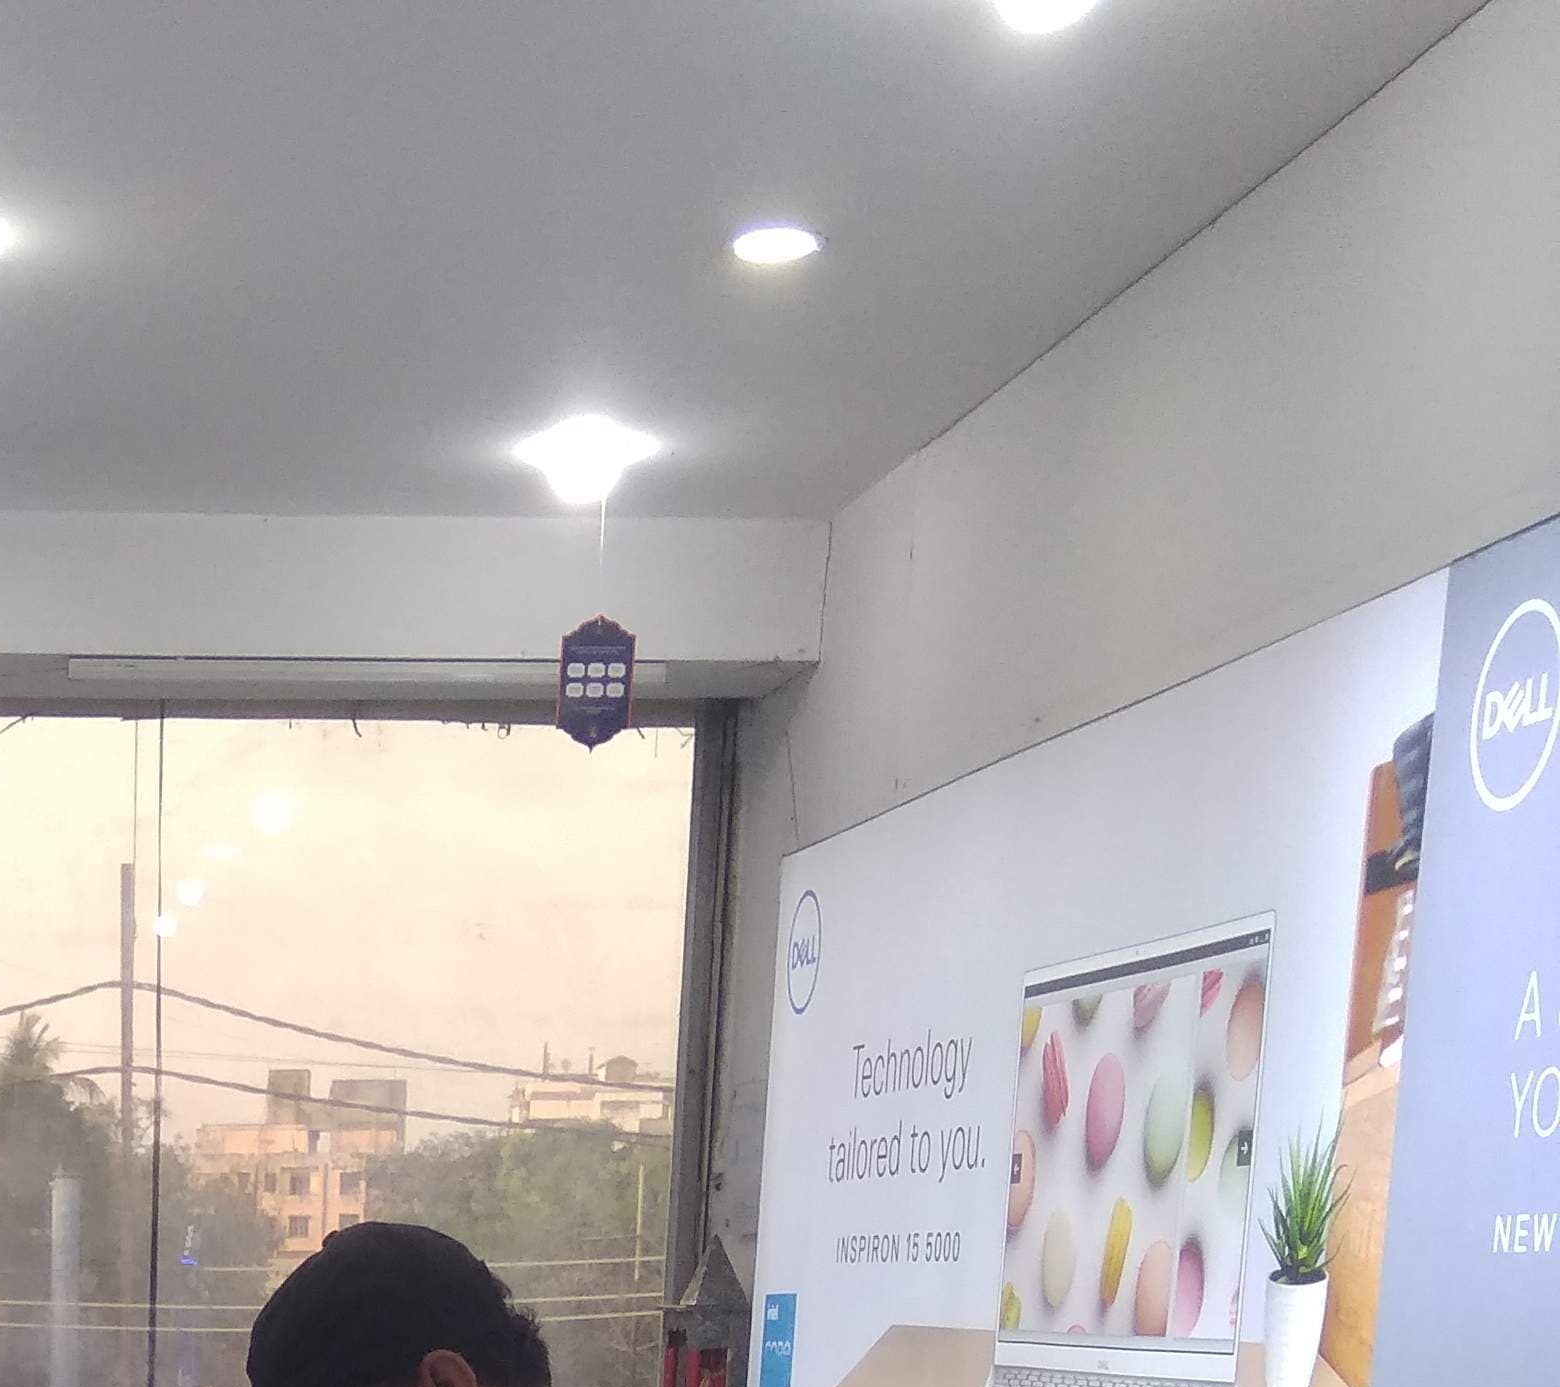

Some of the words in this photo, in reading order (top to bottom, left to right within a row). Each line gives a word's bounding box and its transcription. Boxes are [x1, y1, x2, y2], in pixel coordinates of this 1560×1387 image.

[1482, 671, 1553, 741] DELL
[791, 935, 816, 970] DELL
[1514, 970, 1542, 1040] A
[852, 1028, 973, 1099] Technology
[828, 1119, 903, 1184] tailored
[910, 1124, 931, 1174] to
[938, 1125, 986, 1184] you.
[836, 1233, 901, 1264] INSPIRON
[906, 1232, 920, 1263] 15
[925, 1231, 961, 1263] 5000
[1493, 1212, 1558, 1253] NEW
